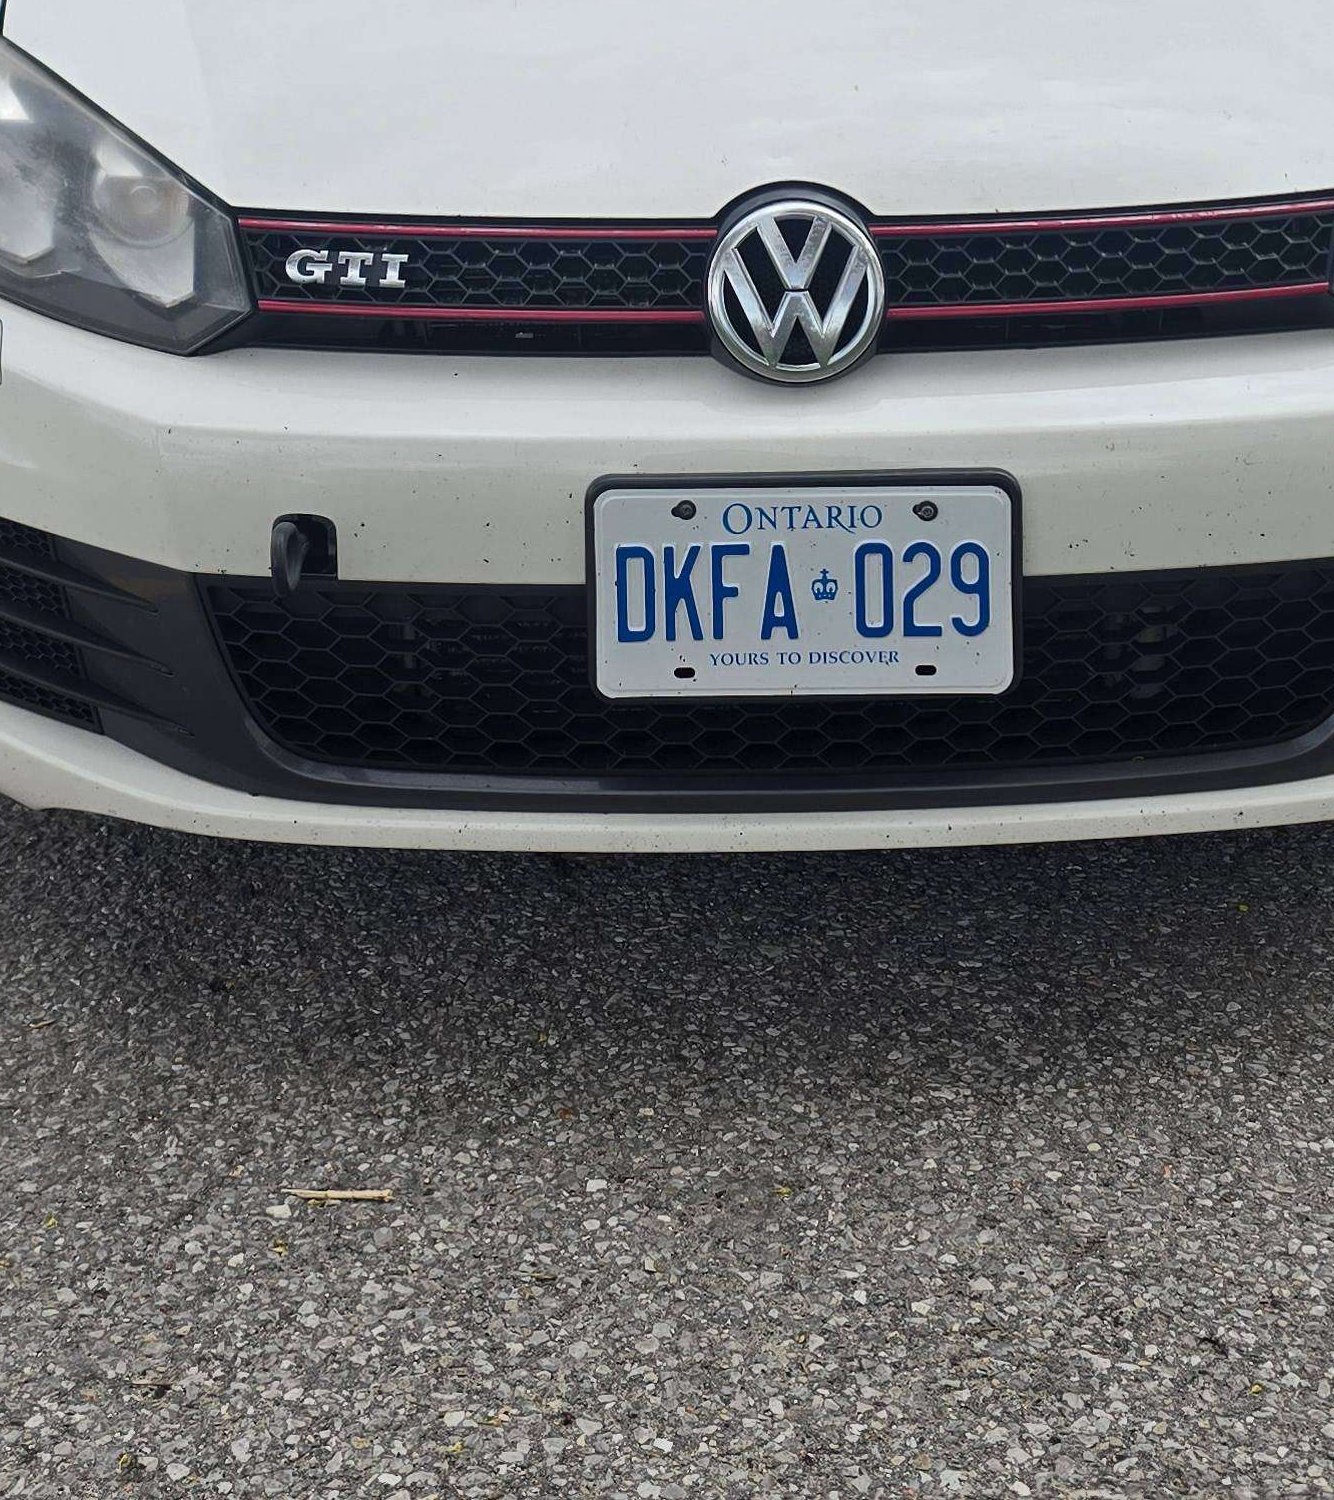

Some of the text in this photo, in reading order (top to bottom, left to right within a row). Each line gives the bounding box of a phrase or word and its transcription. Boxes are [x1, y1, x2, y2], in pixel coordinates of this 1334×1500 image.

[285, 249, 409, 288] GTI
[722, 502, 883, 535] ONTARIO
[615, 541, 992, 643] DKFA 029
[709, 650, 900, 667] YOURS TO DISCOVER
